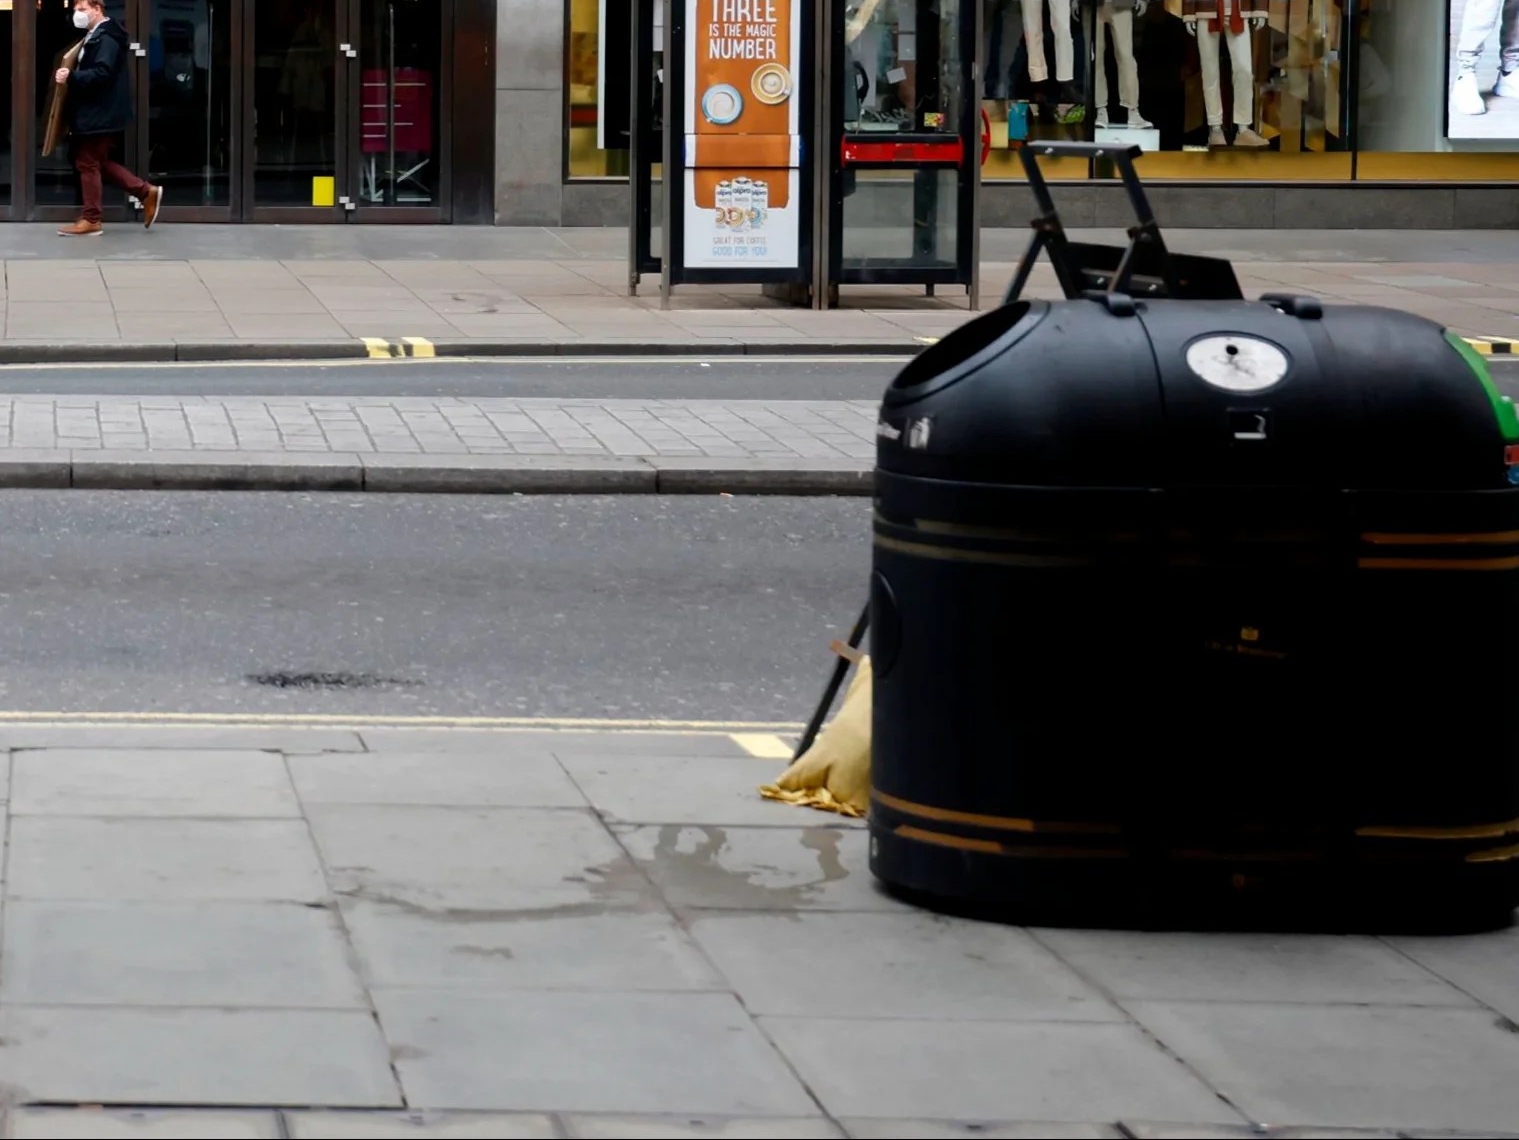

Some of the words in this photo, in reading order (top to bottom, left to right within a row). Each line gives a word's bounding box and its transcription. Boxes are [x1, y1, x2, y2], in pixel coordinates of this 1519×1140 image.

[709, 23, 719, 37] IS
[723, 23, 742, 37] THE
[745, 24, 777, 37] MAGIC
[709, 38, 777, 59] NUMBER
